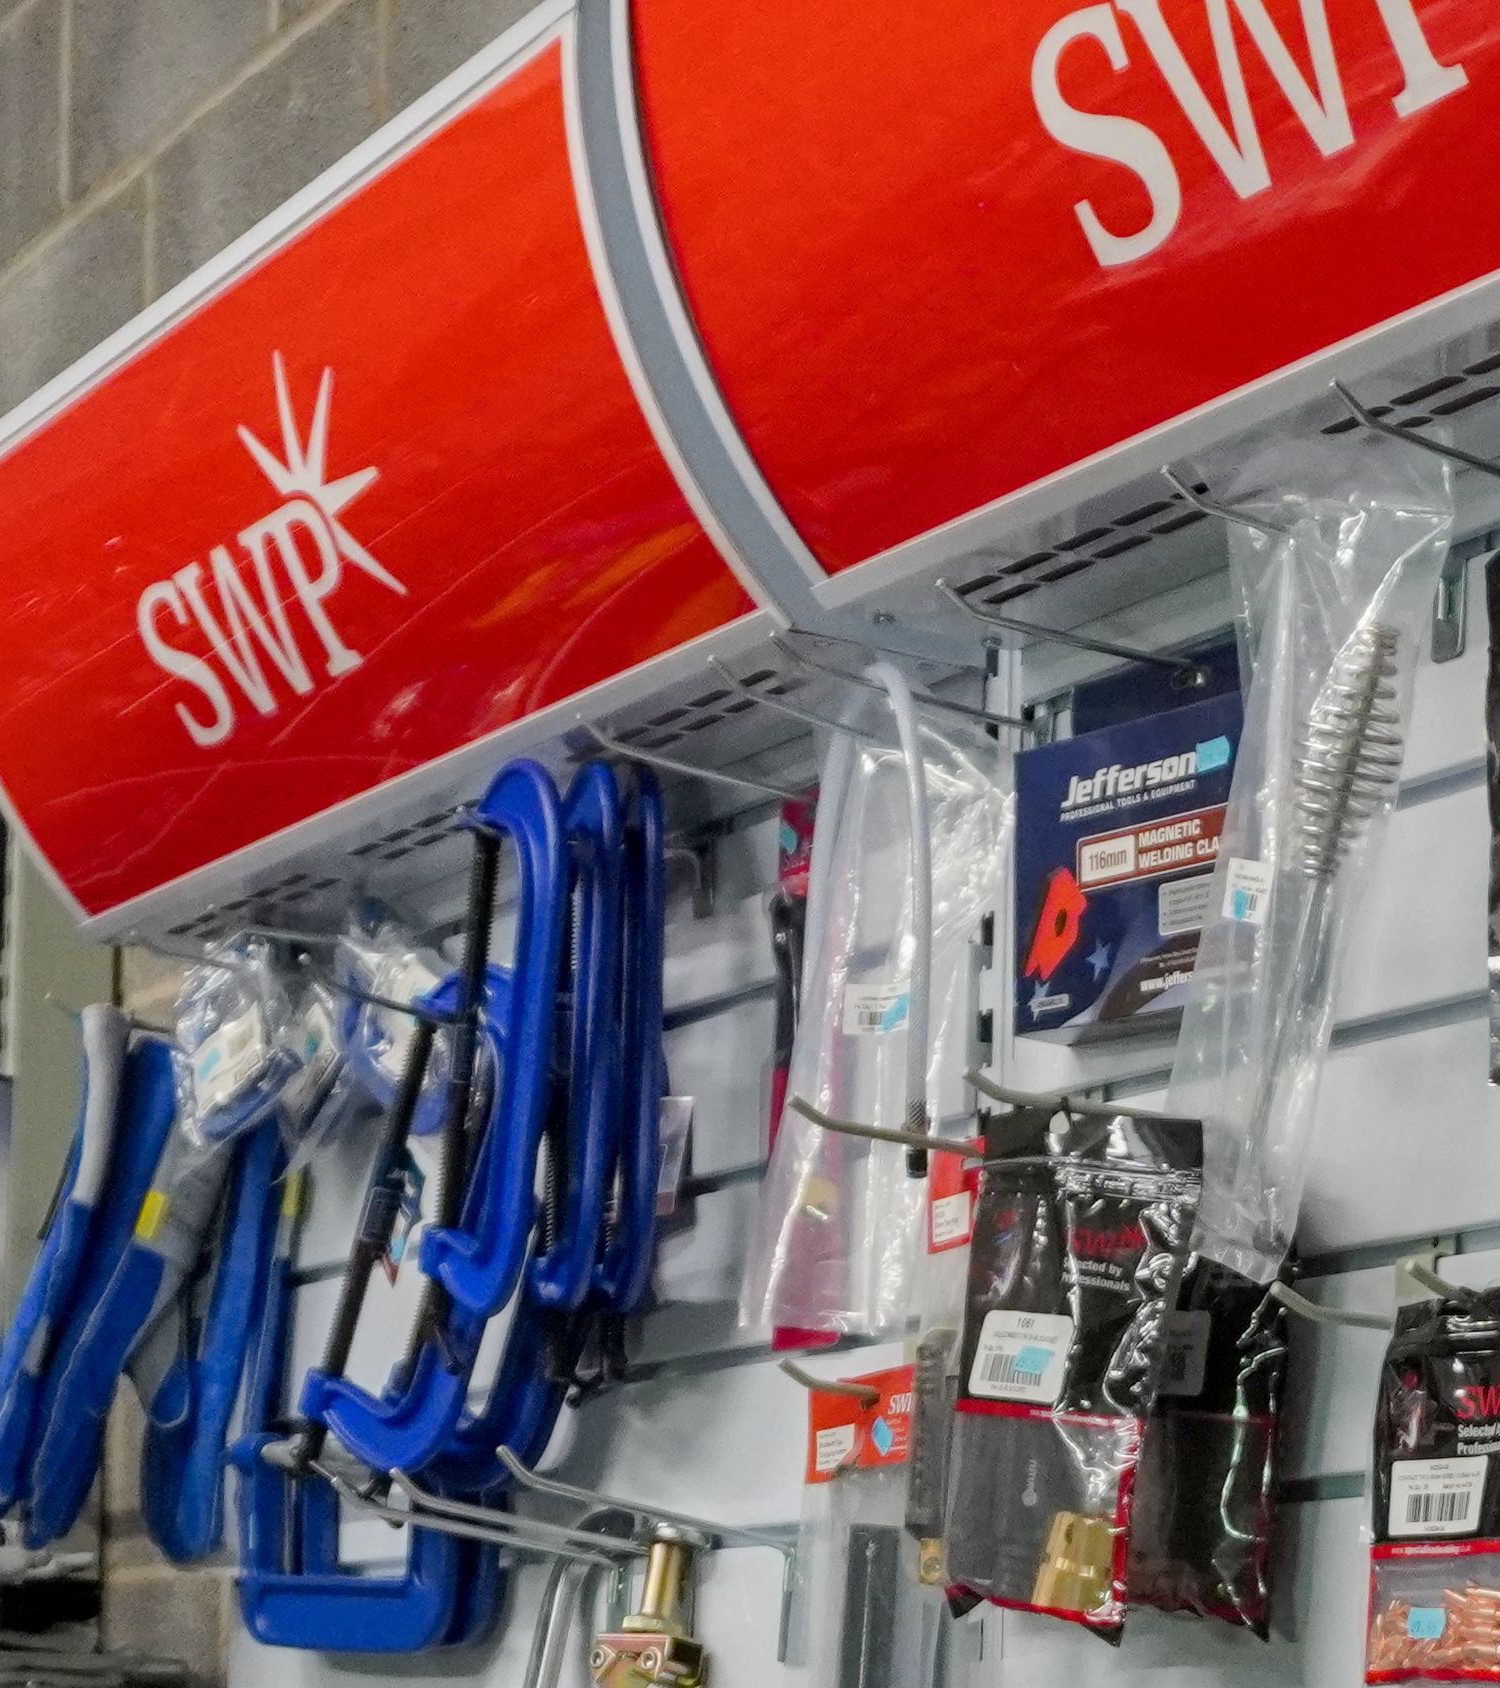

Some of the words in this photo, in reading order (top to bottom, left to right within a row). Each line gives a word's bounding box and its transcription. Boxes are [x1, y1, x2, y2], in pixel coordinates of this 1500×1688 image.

[138, 498, 365, 748] SWP
[1061, 751, 1197, 808] Jefferson
[1059, 801, 1113, 823] PROFESSIONAL
[1117, 794, 1141, 808] TOOLS
[1151, 780, 1195, 799] EQUIPMENT
[1138, 819, 1200, 848] MAGNETIC
[1139, 845, 1193, 869] WELDING
[1197, 836, 1220, 856] CLA
[1088, 848, 1127, 871] 116mm
